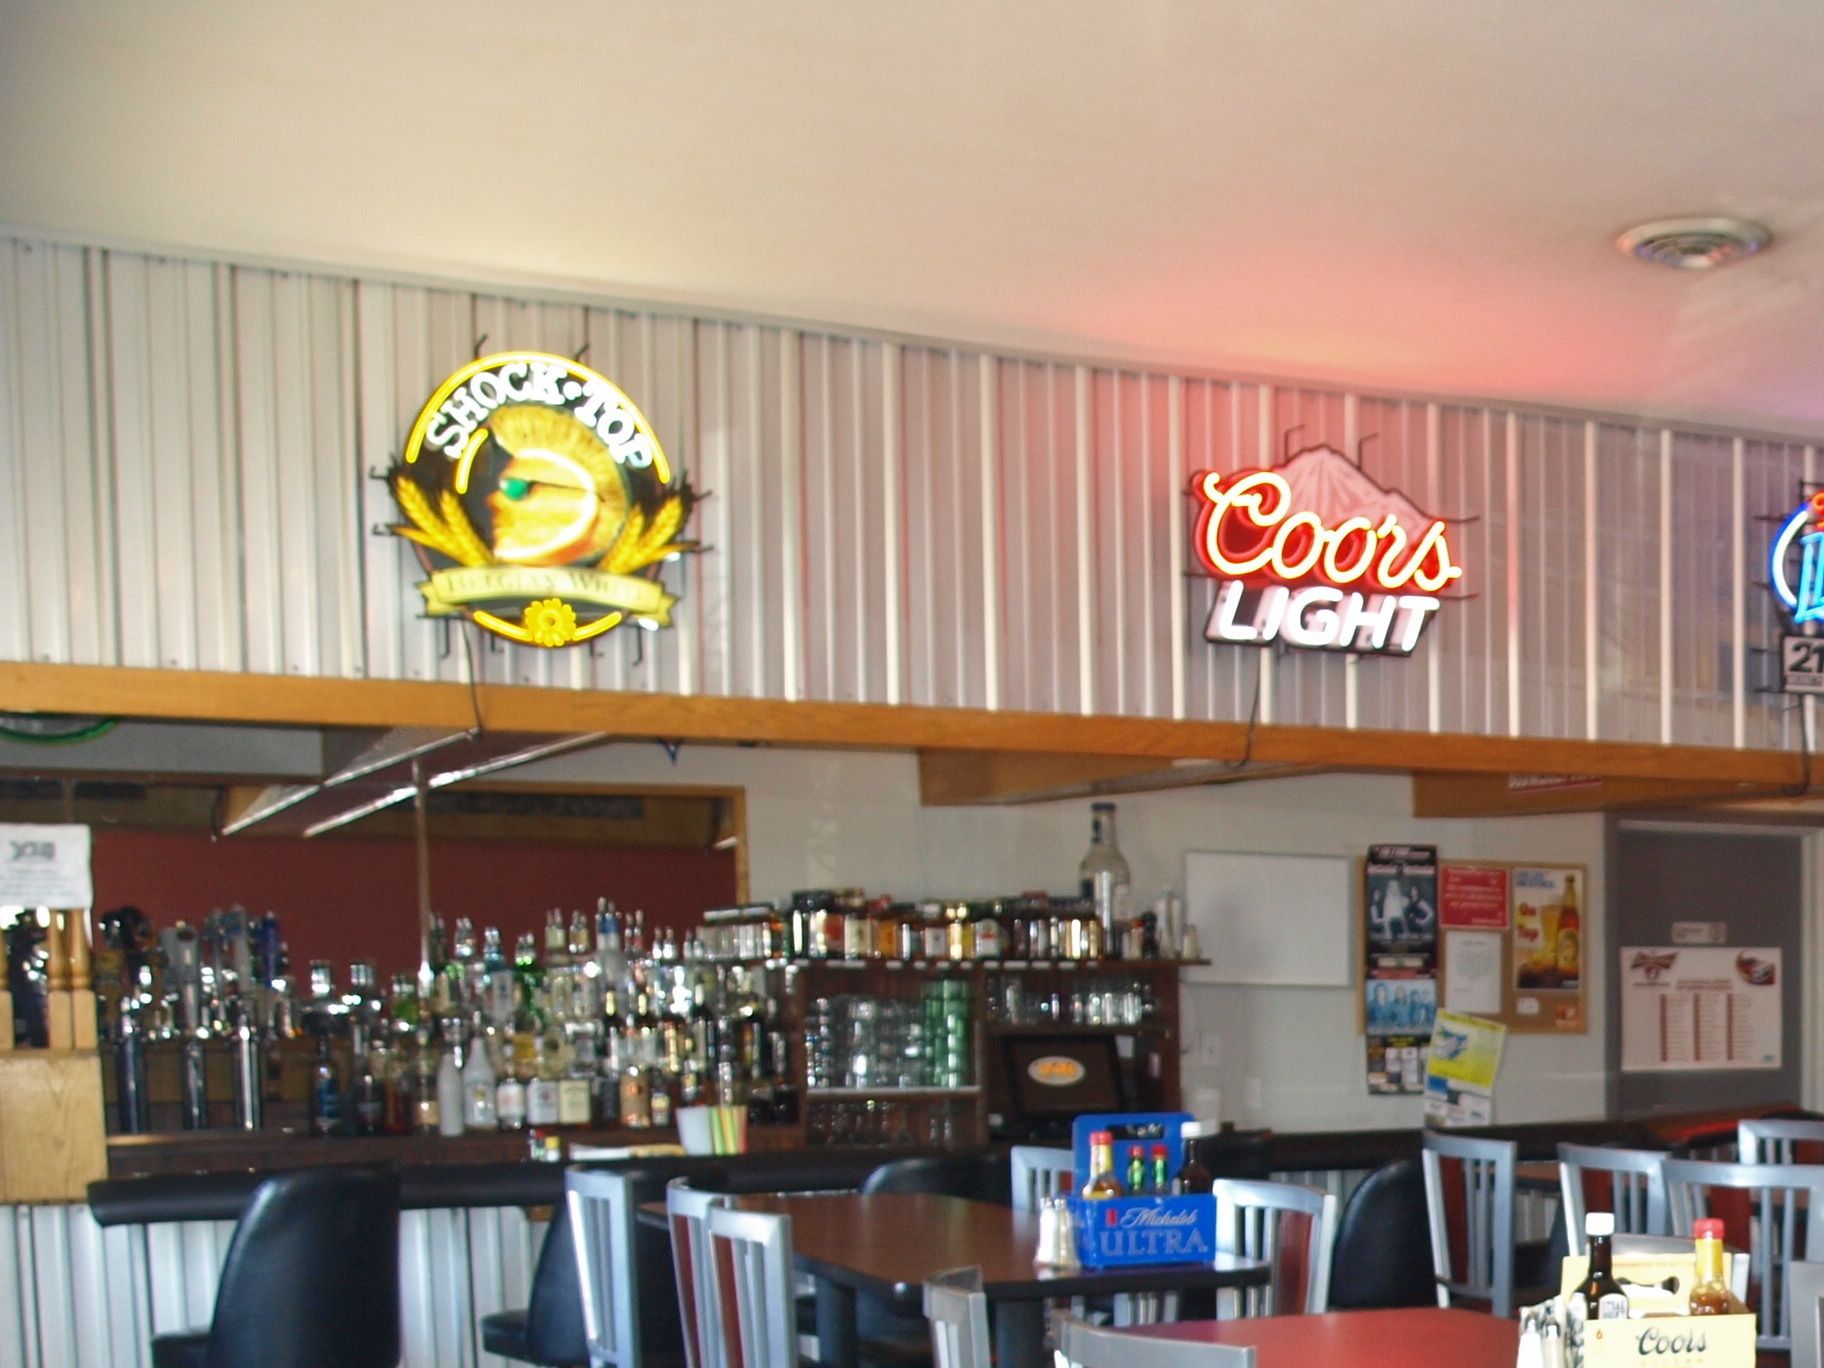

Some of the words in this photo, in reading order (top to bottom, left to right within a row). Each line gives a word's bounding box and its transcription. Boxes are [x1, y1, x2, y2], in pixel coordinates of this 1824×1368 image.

[1203, 471, 1463, 592] Coors
[1218, 579, 1440, 651] LIGHT
[1119, 1206, 1199, 1229] Michelob
[1099, 1227, 1209, 1258] ULTRA
[1635, 1326, 1707, 1356] Coors
